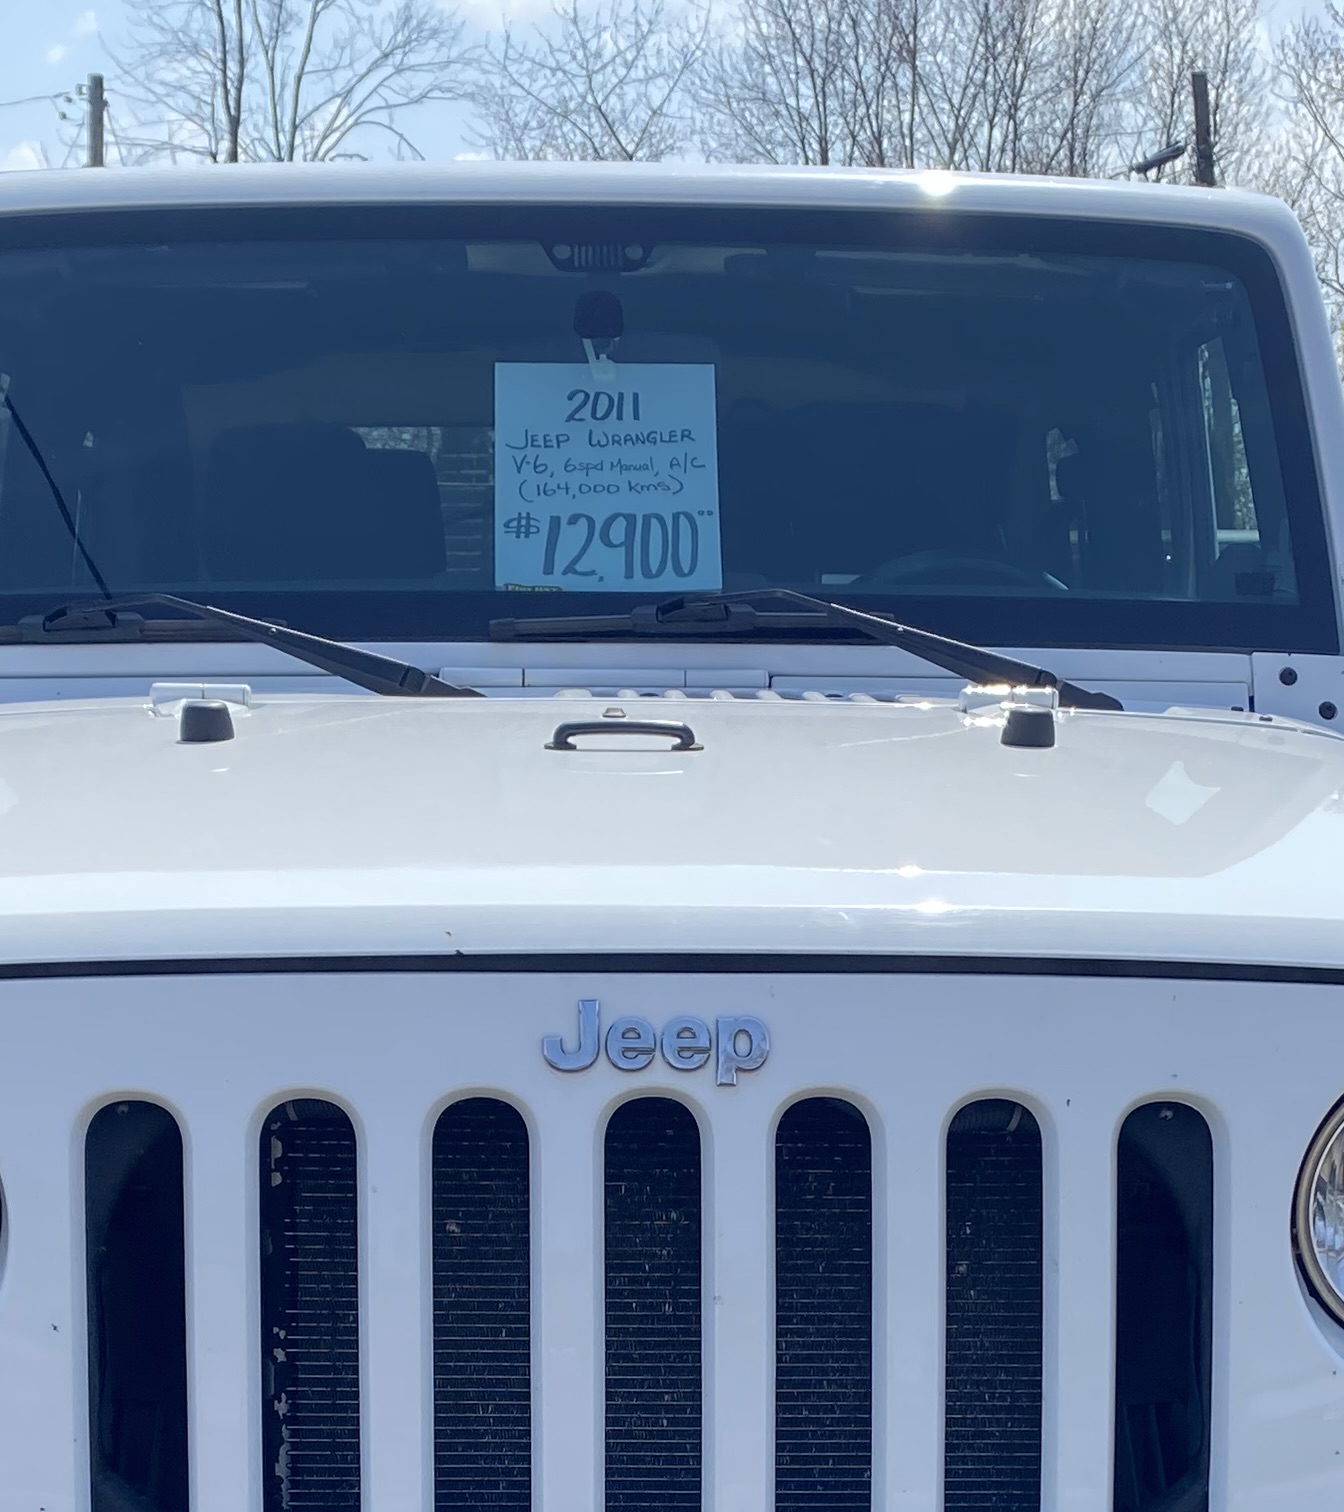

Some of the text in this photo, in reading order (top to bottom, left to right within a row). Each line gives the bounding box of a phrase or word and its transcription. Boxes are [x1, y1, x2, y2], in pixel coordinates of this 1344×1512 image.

[565, 389, 640, 422] 2011
[505, 429, 695, 449] JEEP WRANGLER
[669, 452, 706, 474] A/C
[542, 999, 770, 1087] Jeep
